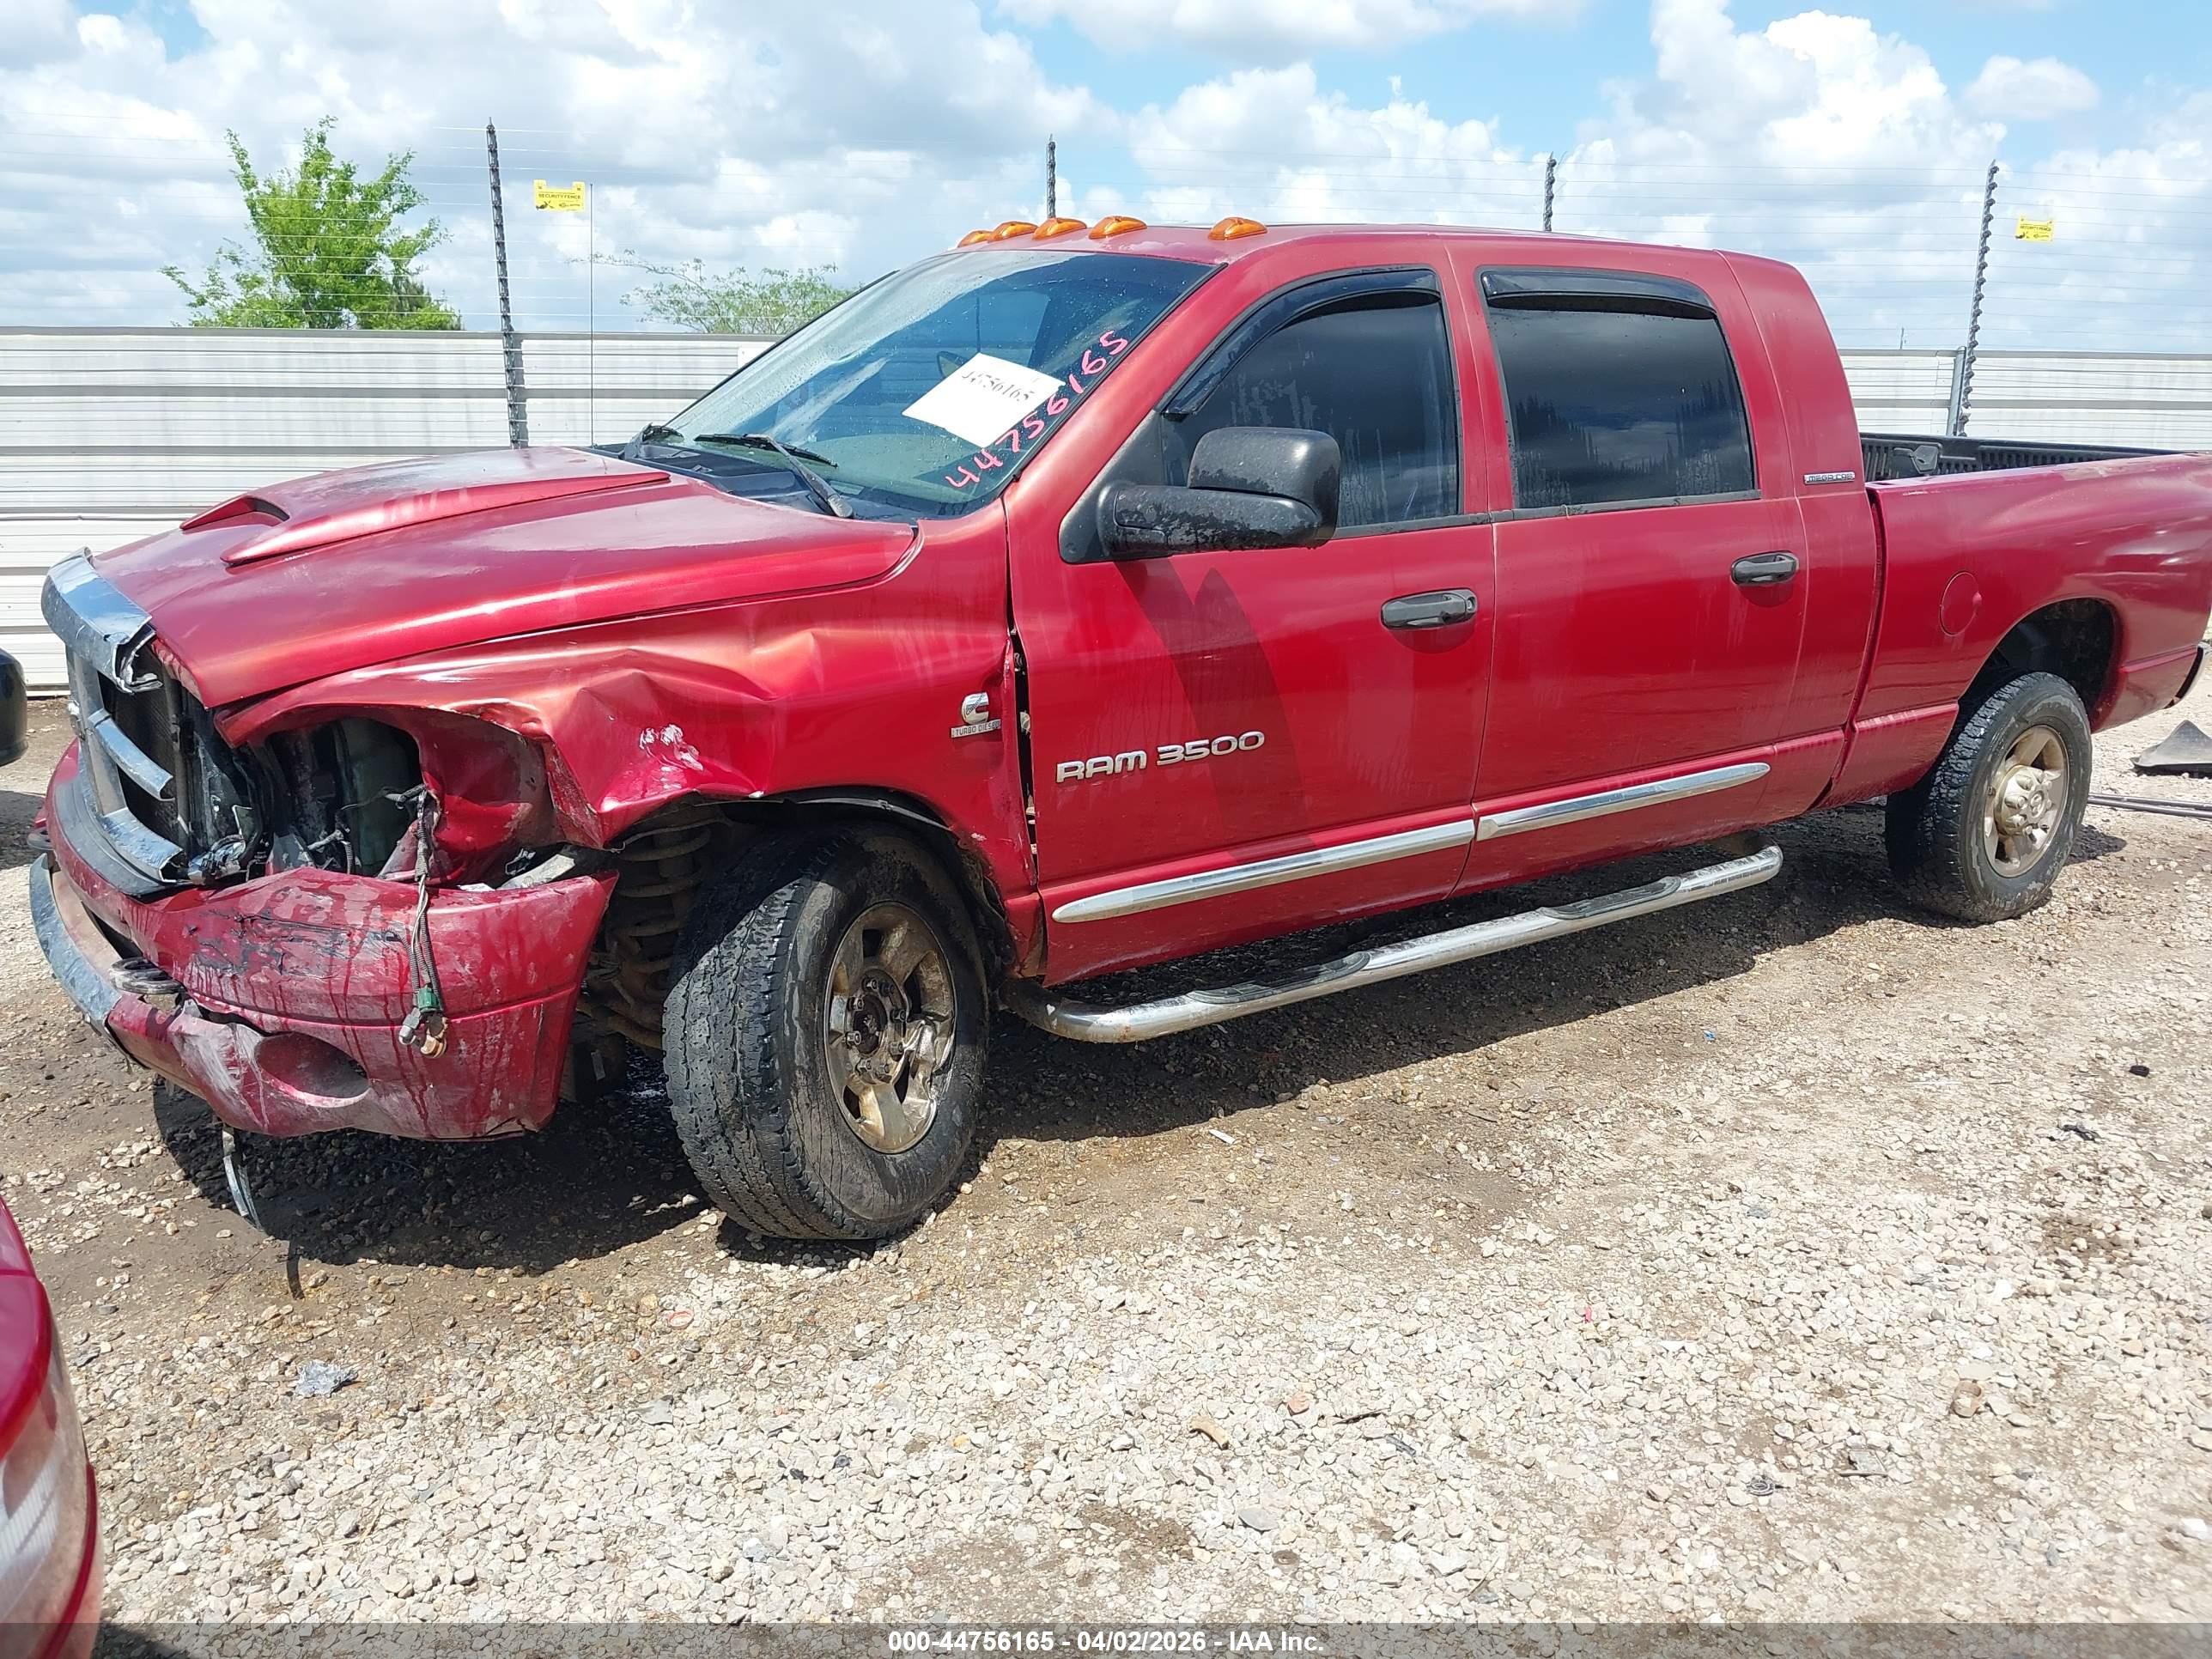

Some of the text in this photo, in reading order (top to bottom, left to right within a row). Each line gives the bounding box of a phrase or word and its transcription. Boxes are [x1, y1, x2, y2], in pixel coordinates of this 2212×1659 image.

[945, 331, 1127, 488] 44756165
[955, 720, 1001, 736] TURBO DIESEL
[1056, 731, 1265, 783] RAM 3500
